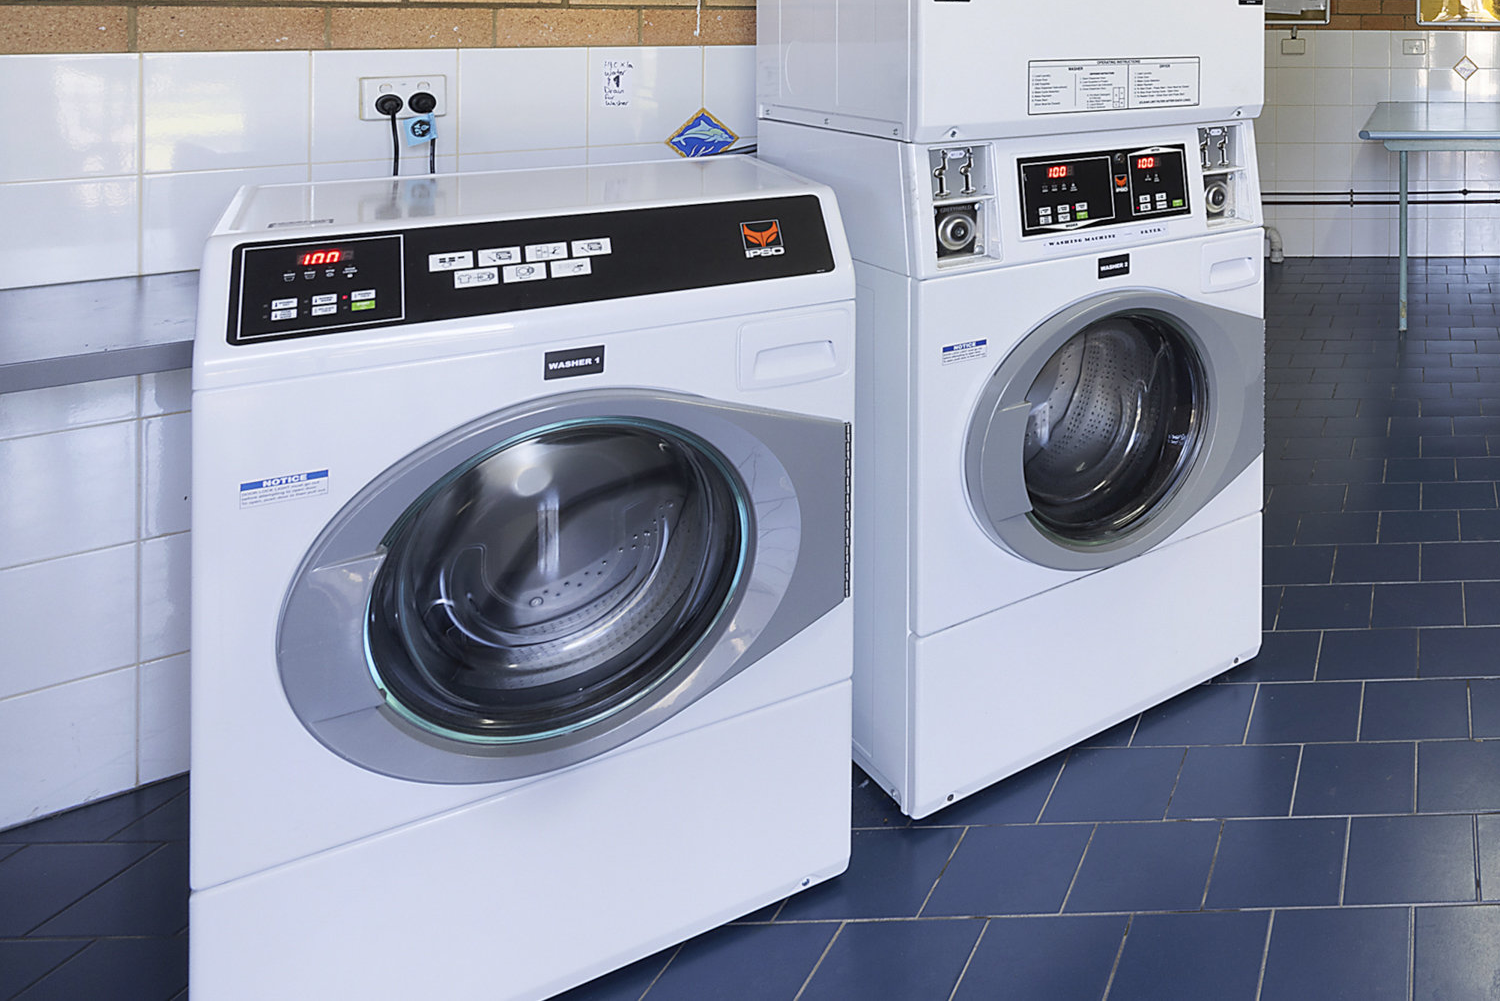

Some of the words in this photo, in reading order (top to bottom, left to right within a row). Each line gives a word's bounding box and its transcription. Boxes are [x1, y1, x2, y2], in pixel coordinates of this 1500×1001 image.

[1138, 157, 1154, 169] 100
[1048, 166, 1067, 178] 100
[1049, 238, 1082, 246] WASHING
[1084, 234, 1116, 242] MACHINE
[745, 246, 785, 258] IPSO
[1100, 262, 1124, 271] WASHER
[548, 358, 592, 370] WASHER
[262, 474, 308, 488] NOTICE
